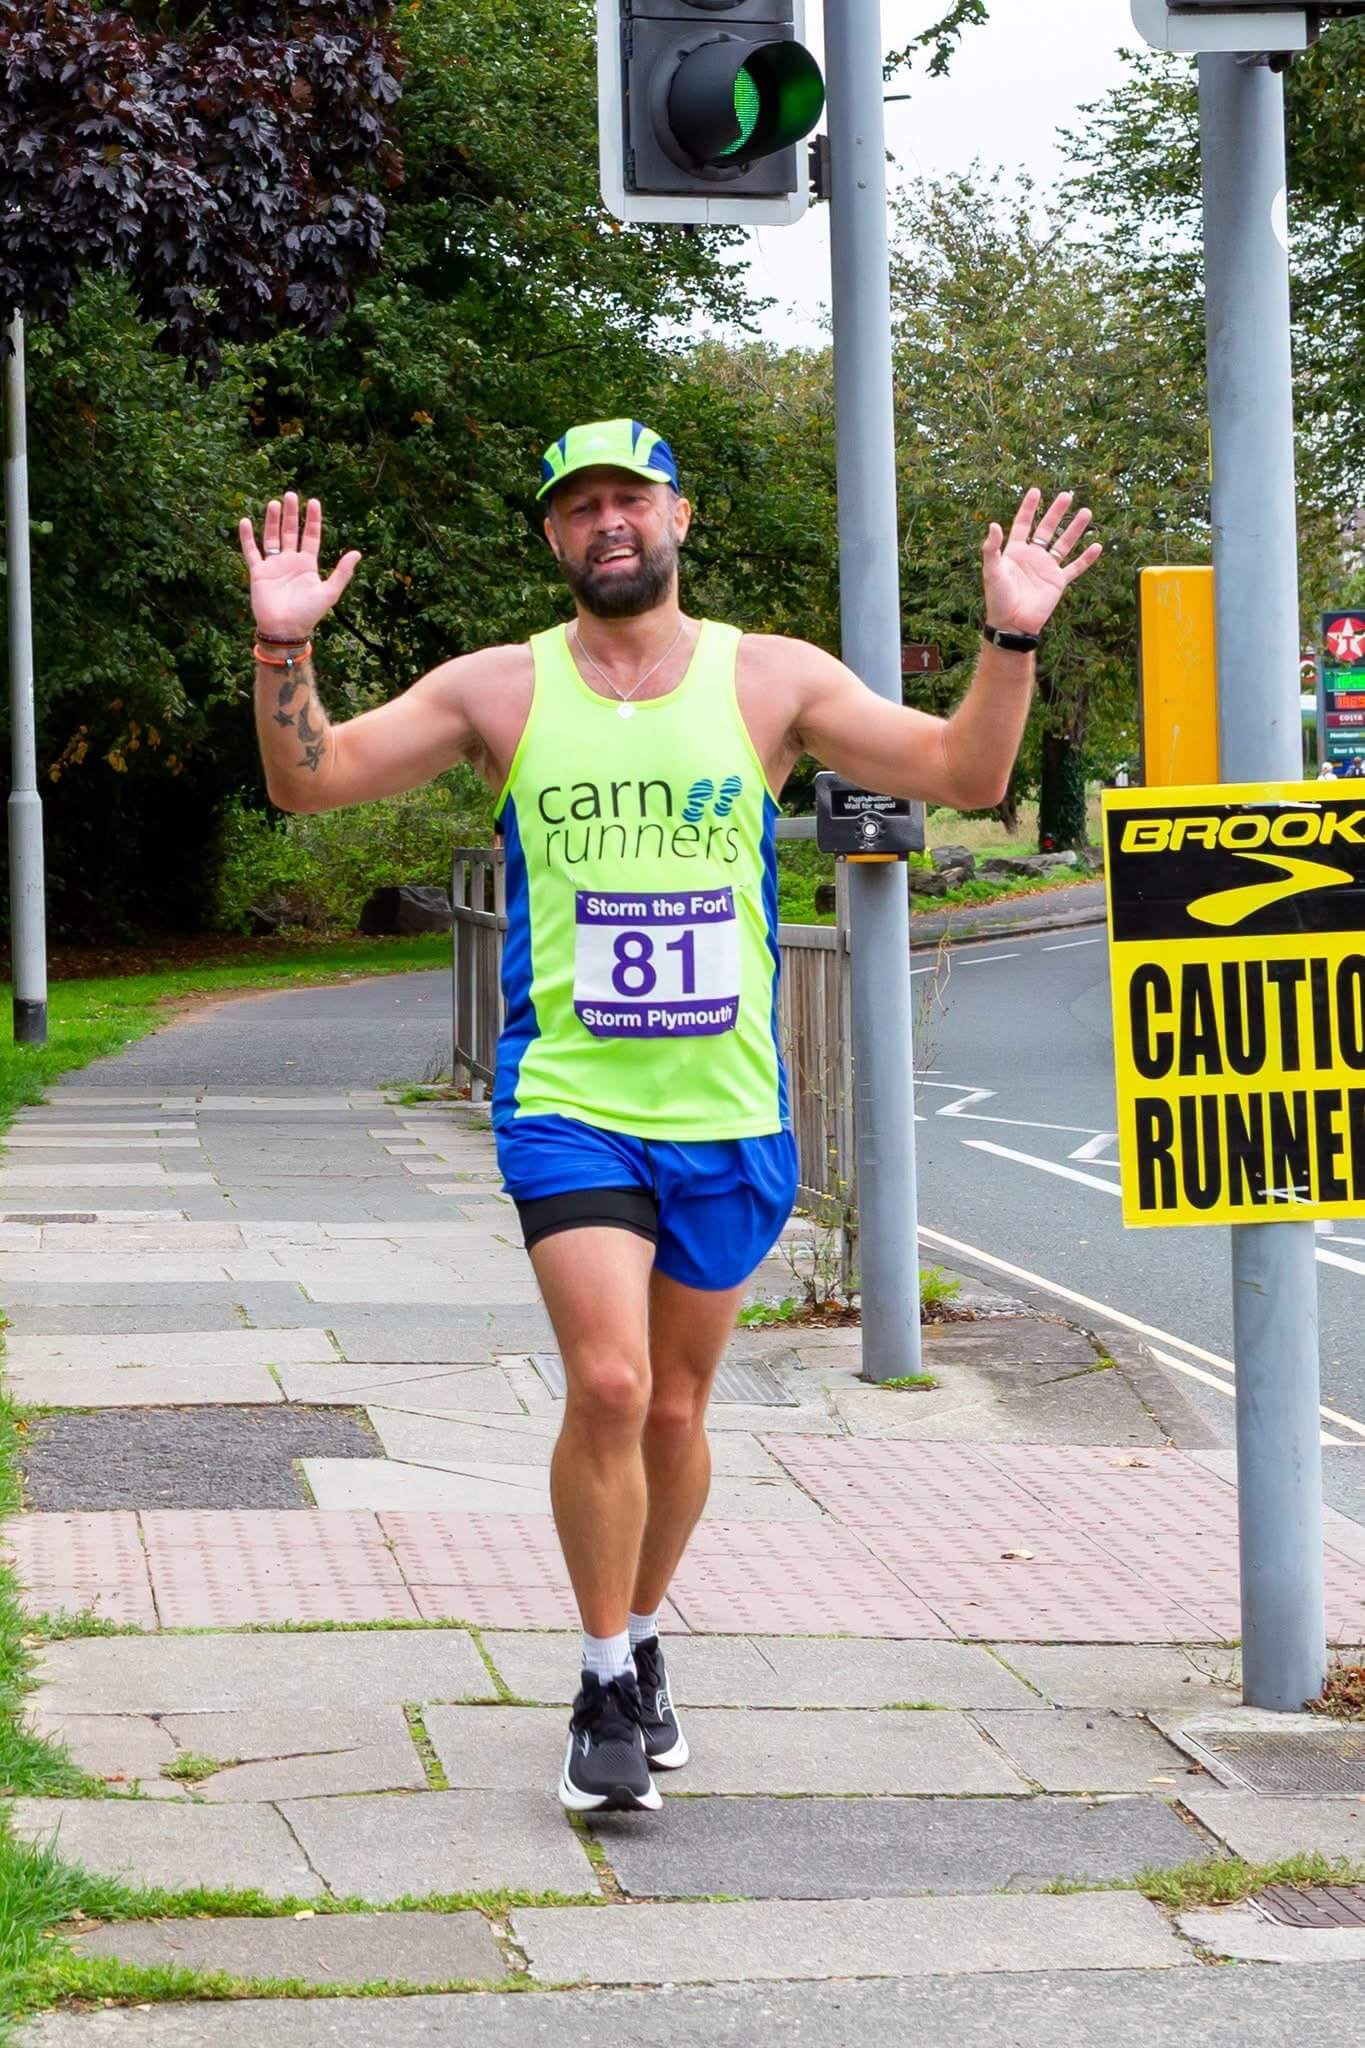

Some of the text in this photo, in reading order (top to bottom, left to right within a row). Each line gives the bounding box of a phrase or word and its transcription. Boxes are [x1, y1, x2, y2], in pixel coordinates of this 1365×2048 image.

[537, 778, 673, 825] carn
[545, 822, 739, 868] runners
[1121, 811, 1365, 853] BROOK
[586, 896, 728, 917] Storm the Fort
[611, 930, 696, 998] 81
[582, 1006, 732, 1029] Storm Plymouth
[1129, 953, 1365, 1080] CAUTIO
